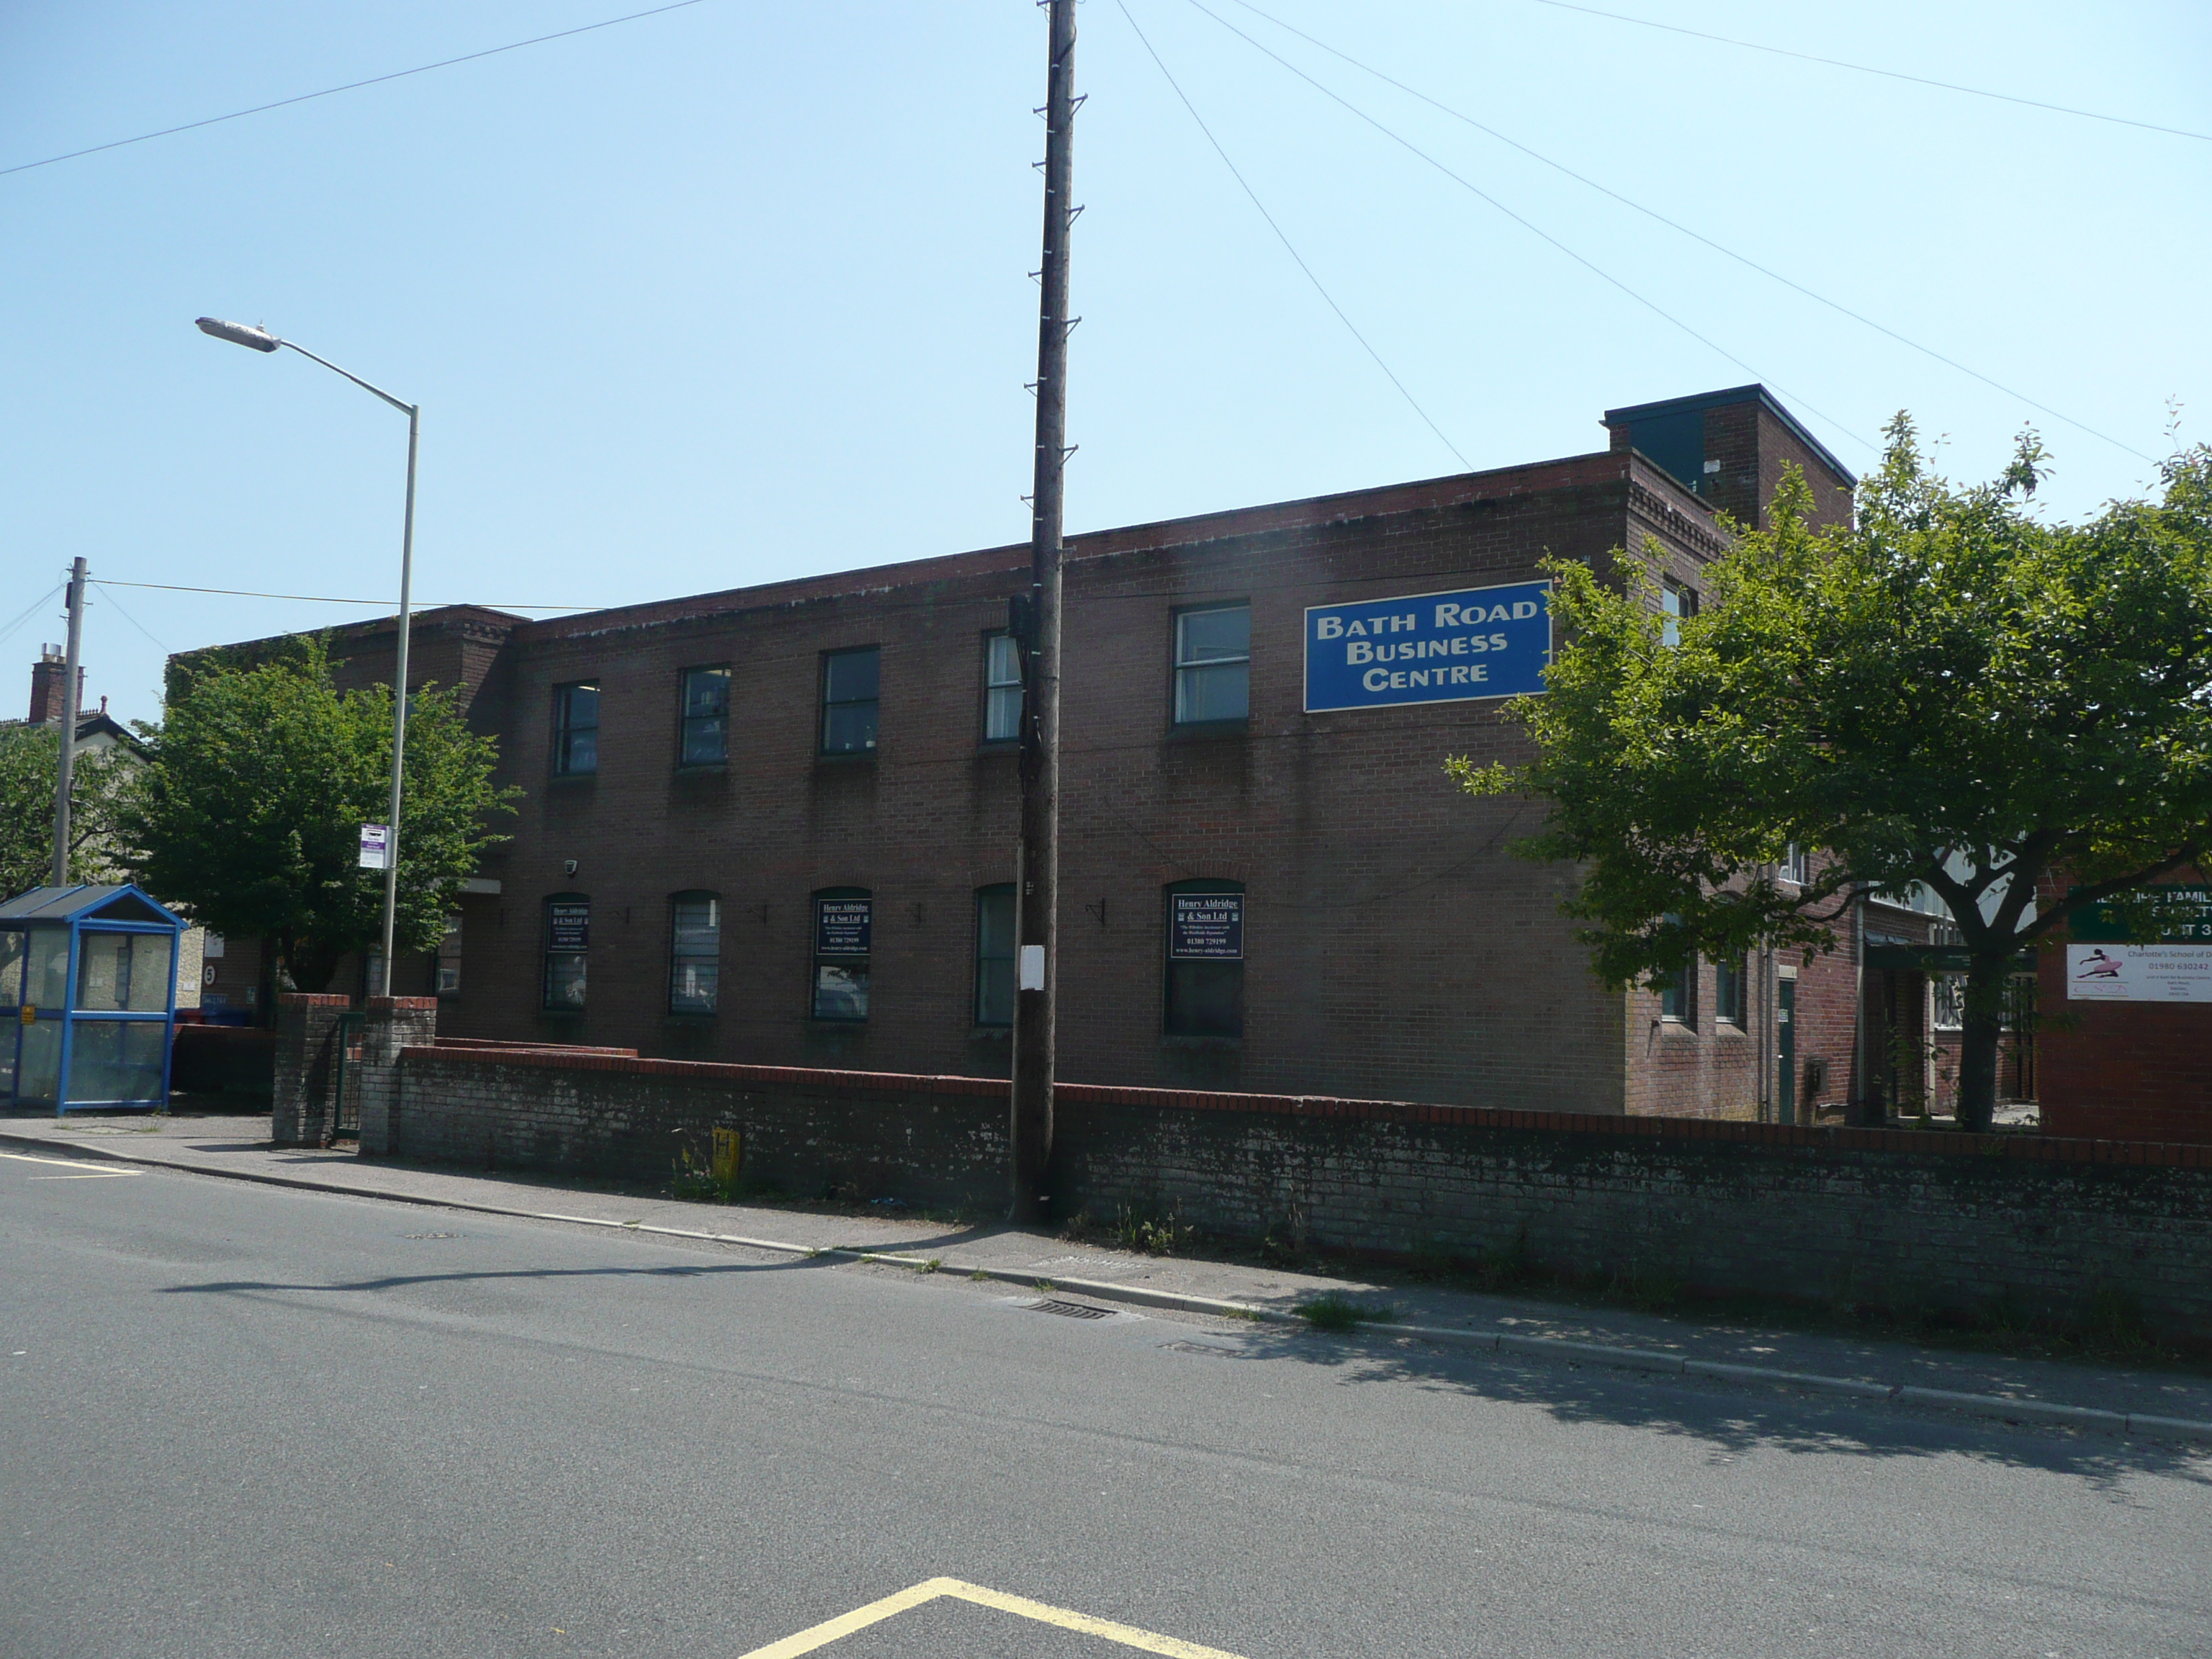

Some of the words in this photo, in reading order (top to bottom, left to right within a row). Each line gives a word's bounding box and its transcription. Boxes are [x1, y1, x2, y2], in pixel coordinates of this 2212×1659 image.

[1317, 613, 1416, 640] BATH
[1435, 601, 1538, 628] ROAD
[1346, 633, 1508, 665] BUSINESS
[1362, 664, 1488, 692] CENTRE
[1178, 899, 1202, 909] Henry
[1203, 899, 1238, 909] Aldridge
[1187, 912, 1195, 920] &
[1196, 912, 1211, 920] Son
[1213, 912, 1228, 920] Ltd
[2160, 924, 2195, 935] UIT
[207, 968, 212, 981] 5
